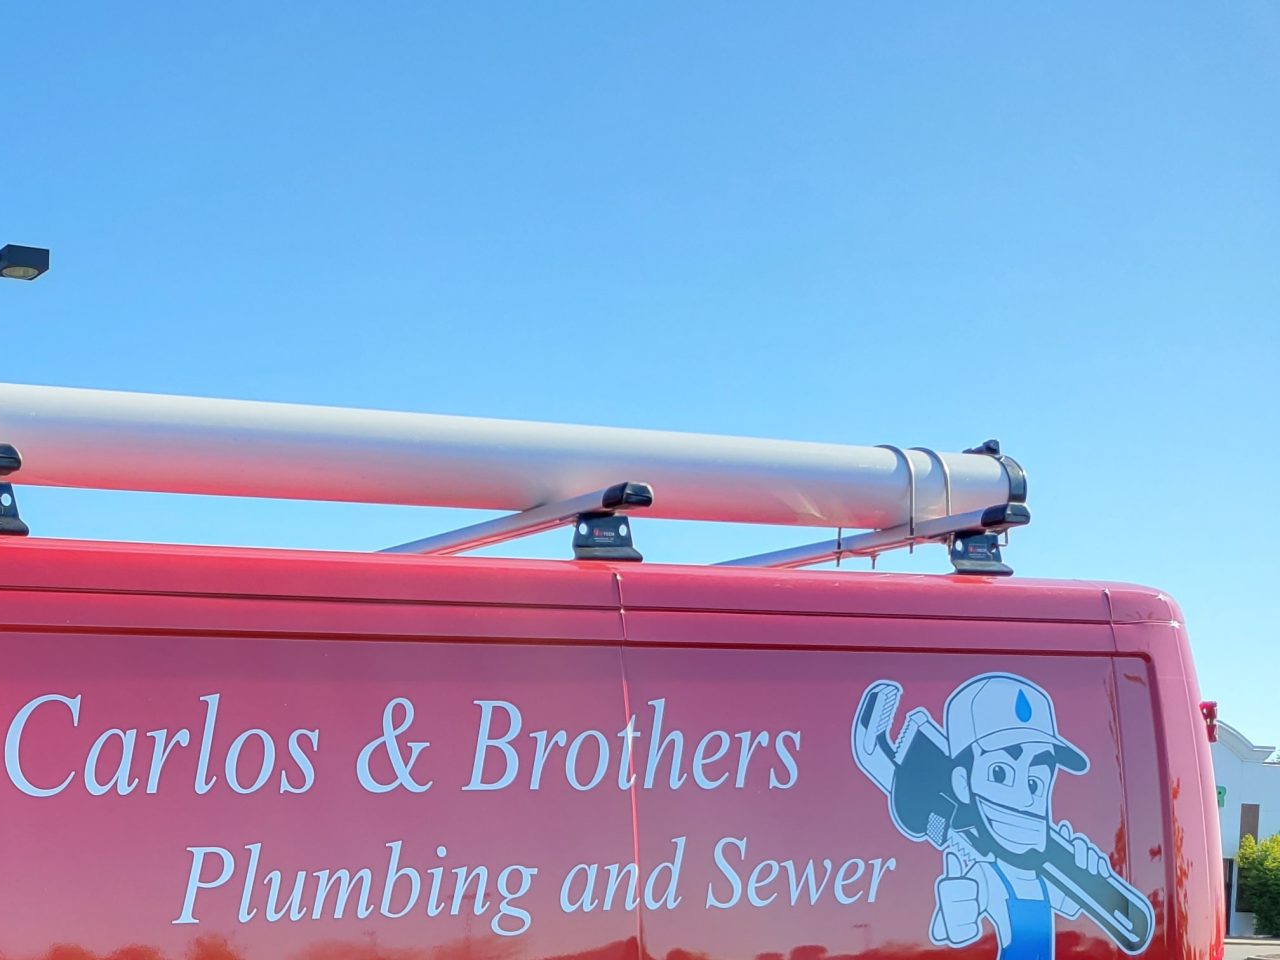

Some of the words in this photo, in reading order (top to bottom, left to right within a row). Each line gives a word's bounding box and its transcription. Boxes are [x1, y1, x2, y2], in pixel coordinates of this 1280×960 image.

[4, 692, 320, 799] Carlos
[356, 696, 433, 794] &
[461, 697, 801, 793] Brothers
[170, 838, 540, 937] Plumbing
[558, 834, 687, 914] and
[704, 835, 897, 910] Sewer
